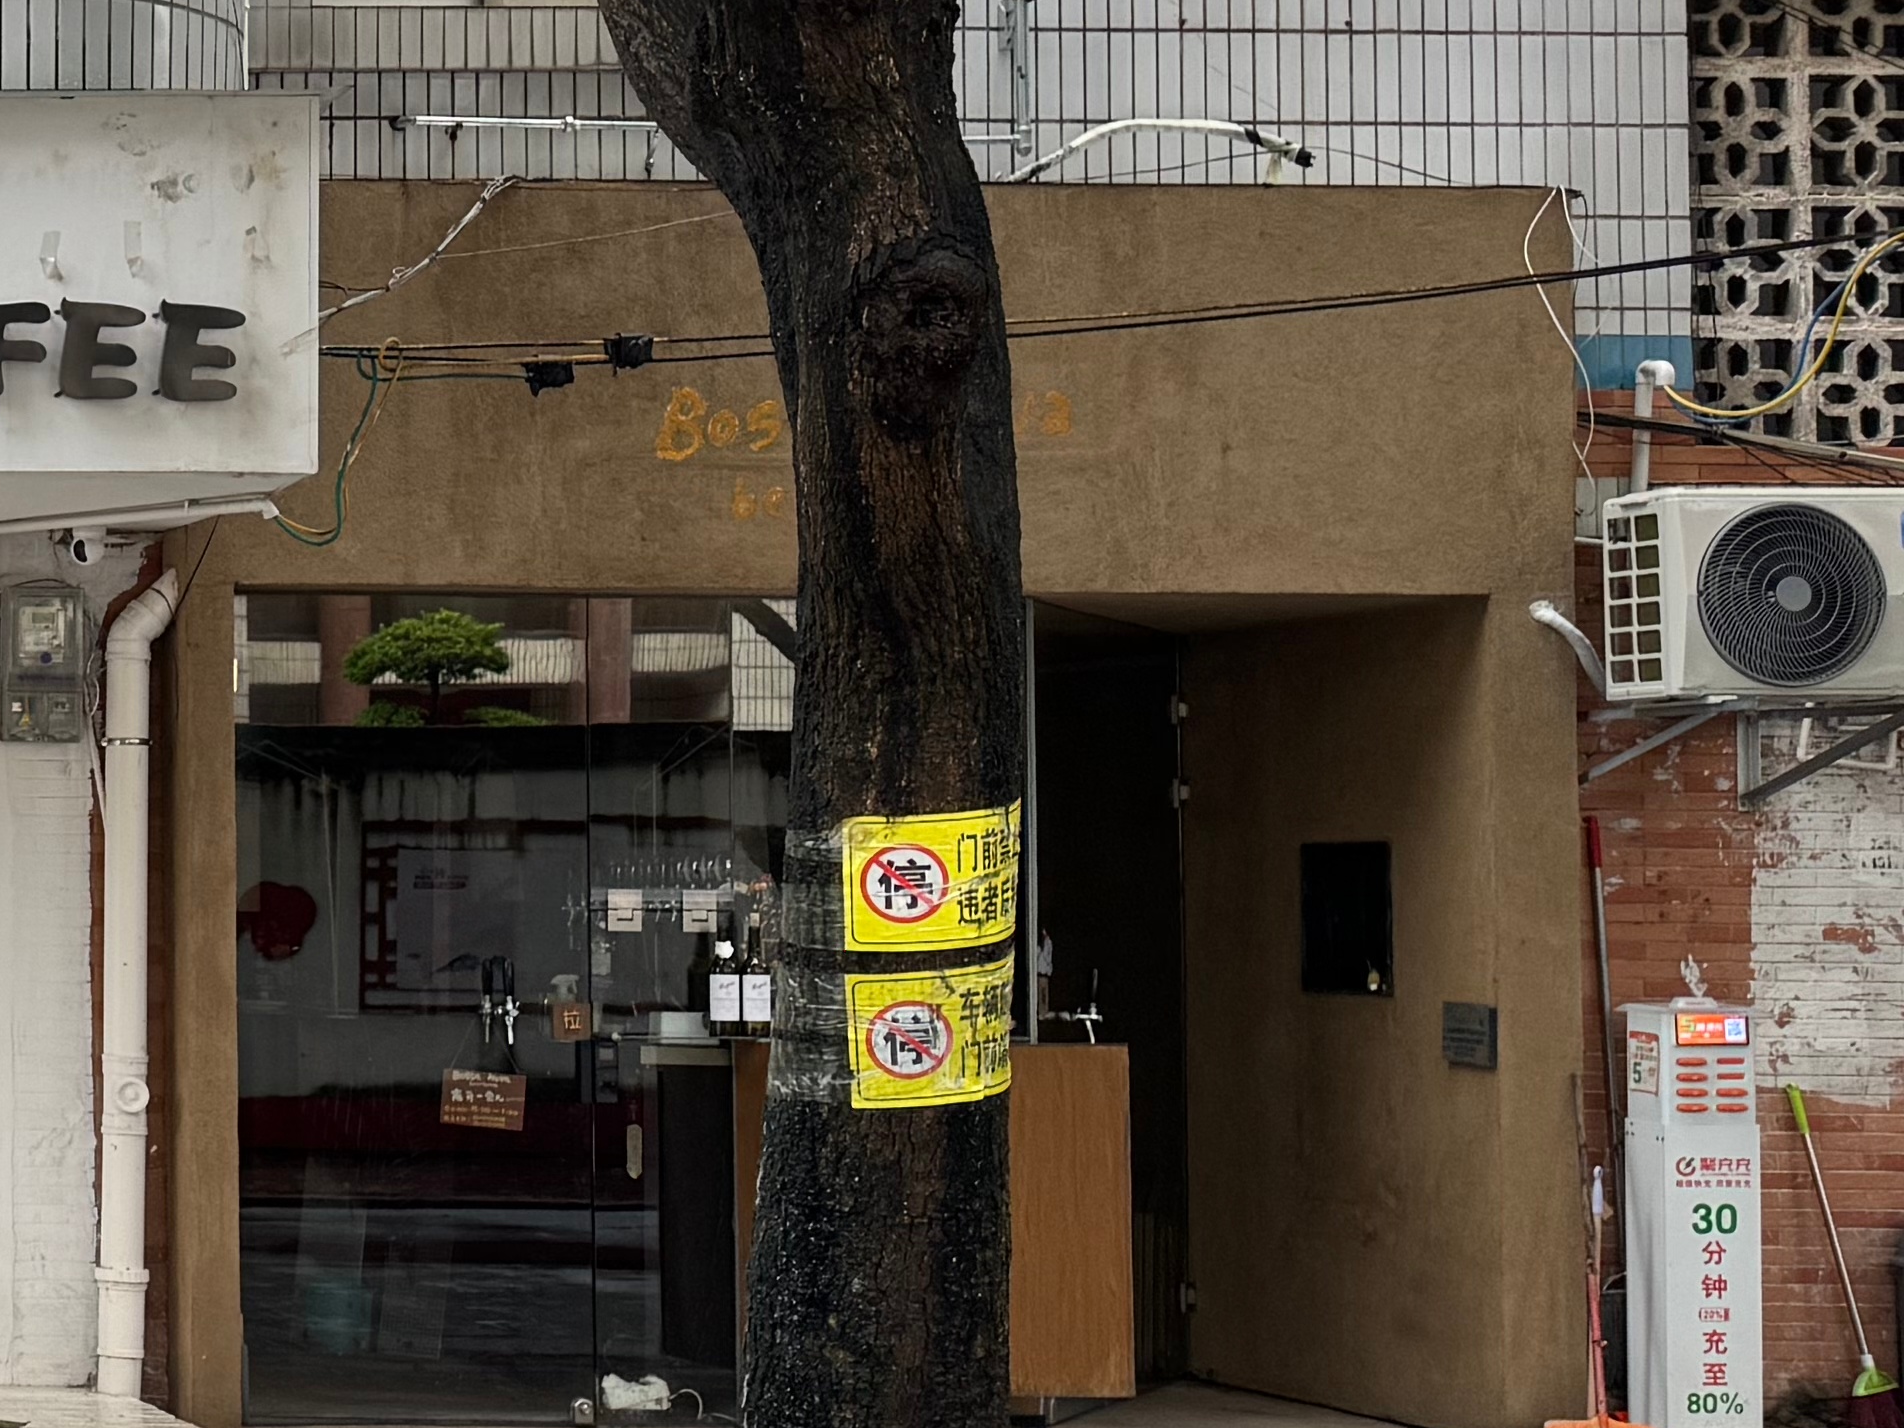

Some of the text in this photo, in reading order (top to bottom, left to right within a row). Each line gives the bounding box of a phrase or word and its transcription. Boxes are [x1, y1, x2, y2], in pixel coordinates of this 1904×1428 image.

[655, 385, 784, 461] Bos
[1691, 1202, 1738, 1235] 30
[1686, 1392, 1744, 1415] 80%
